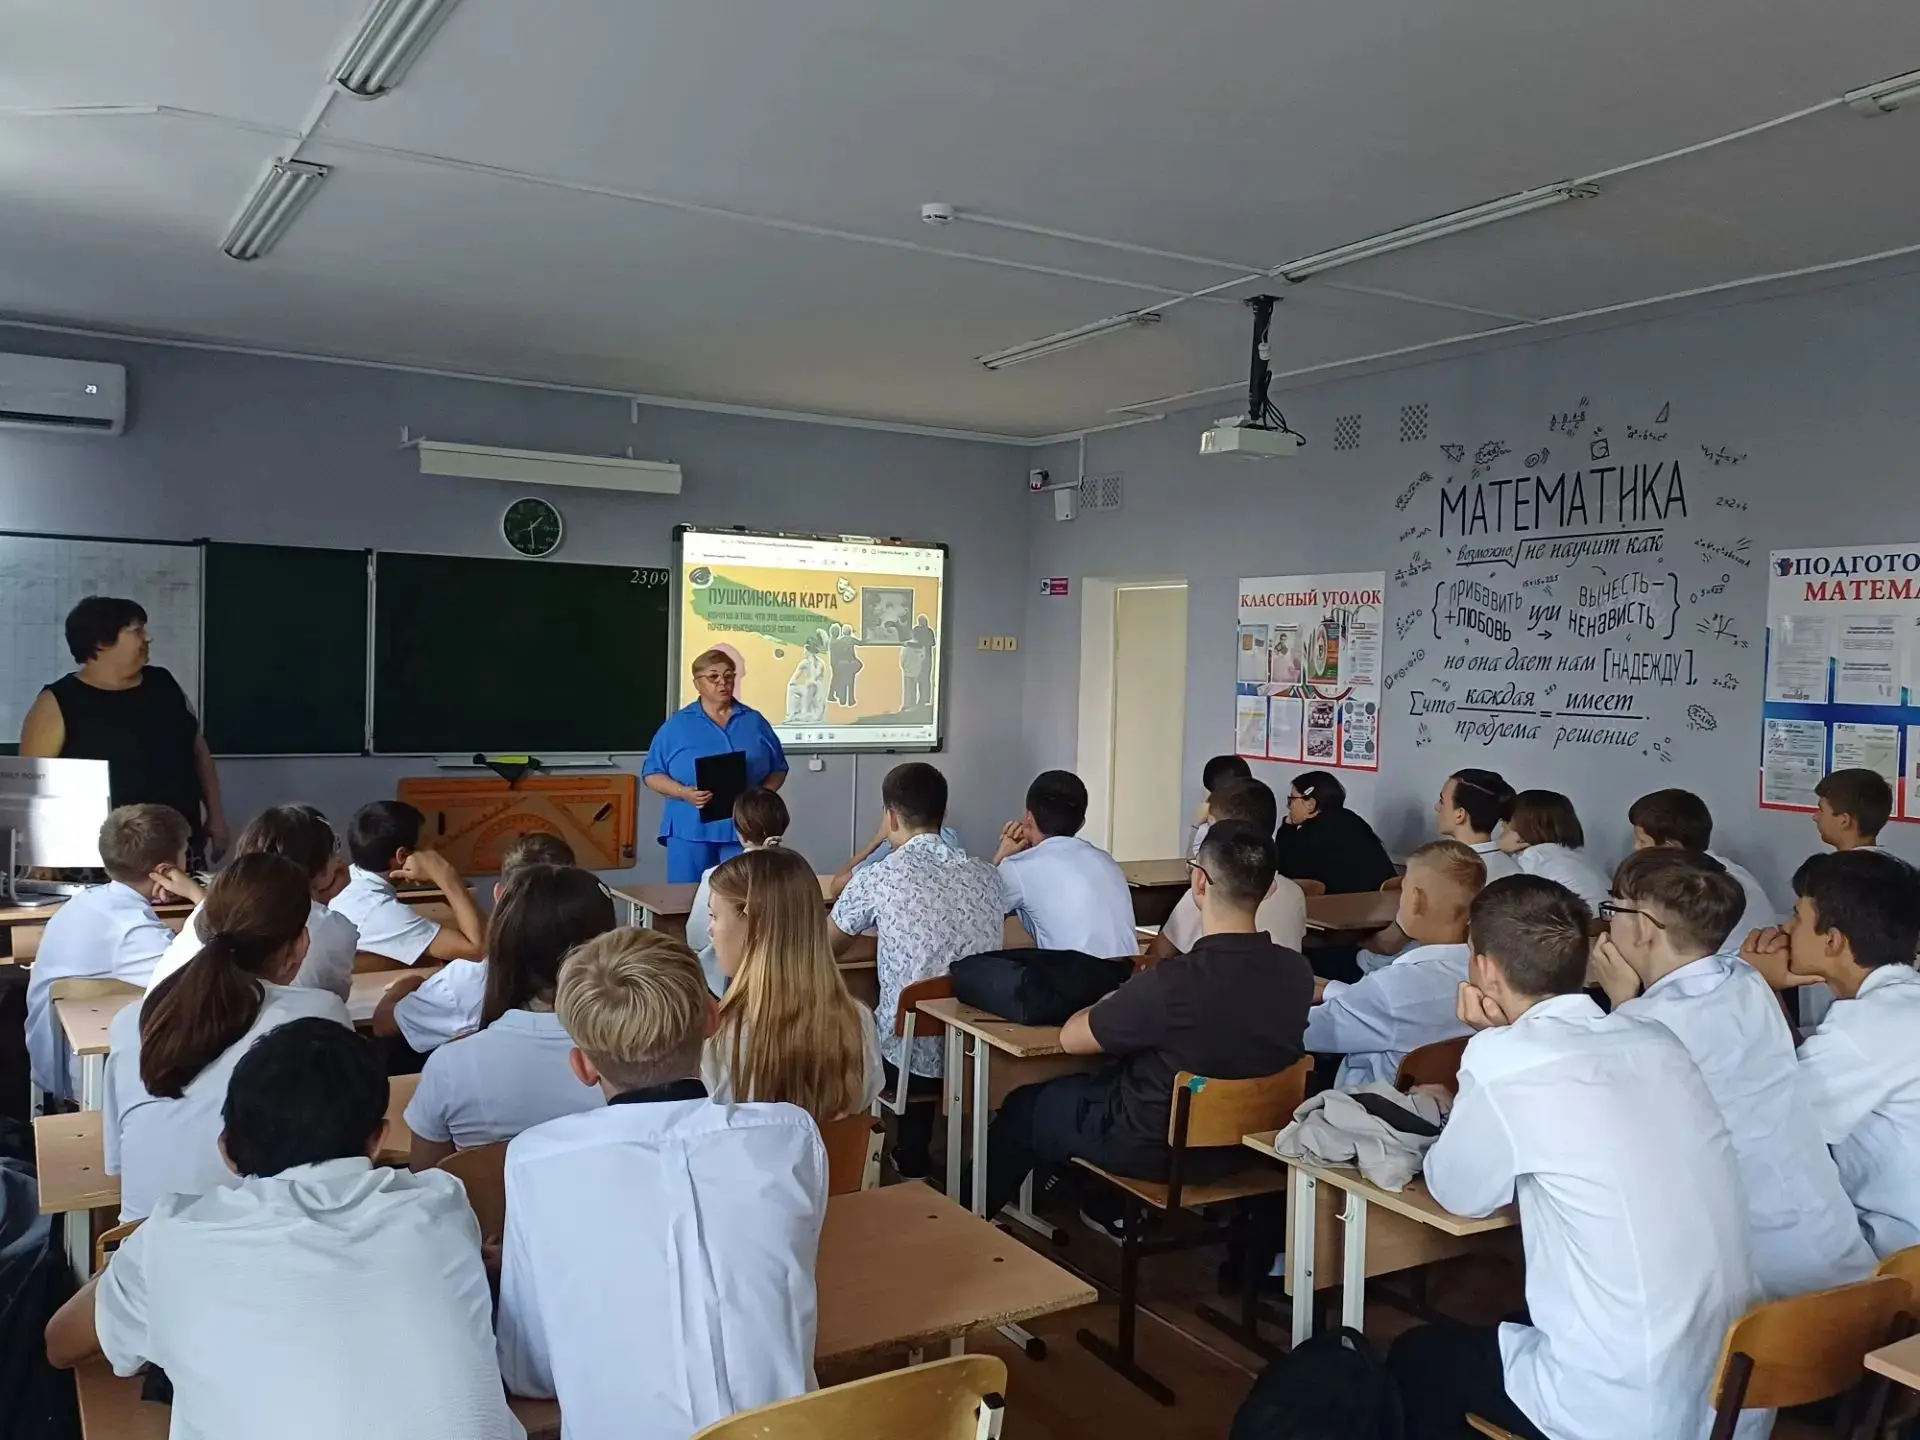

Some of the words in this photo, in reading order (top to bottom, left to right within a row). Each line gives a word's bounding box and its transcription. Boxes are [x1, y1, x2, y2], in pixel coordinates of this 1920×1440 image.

[1439, 459, 1687, 538] МАТЕМАТИКА
[1525, 543, 1544, 560] не
[1550, 538, 1620, 568] научит
[1626, 533, 1664, 555] как
[1794, 552, 1920, 578] ПОДГОТО
[708, 587, 797, 608] ПУШКИНСКАЯ
[799, 592, 838, 609] КАРТА
[1240, 588, 1318, 608] КЛАССНЫЙ
[1322, 589, 1382, 608] УГОЛОК
[1527, 604, 1562, 631] или
[1444, 654, 1464, 671] но
[1467, 655, 1502, 672] она
[1504, 647, 1551, 672] дает
[1556, 654, 1596, 672] нам
[1465, 681, 1537, 707] каждая
[1565, 690, 1635, 713] имеет
[1454, 714, 1542, 746] проблема
[1553, 726, 1640, 750] решение
